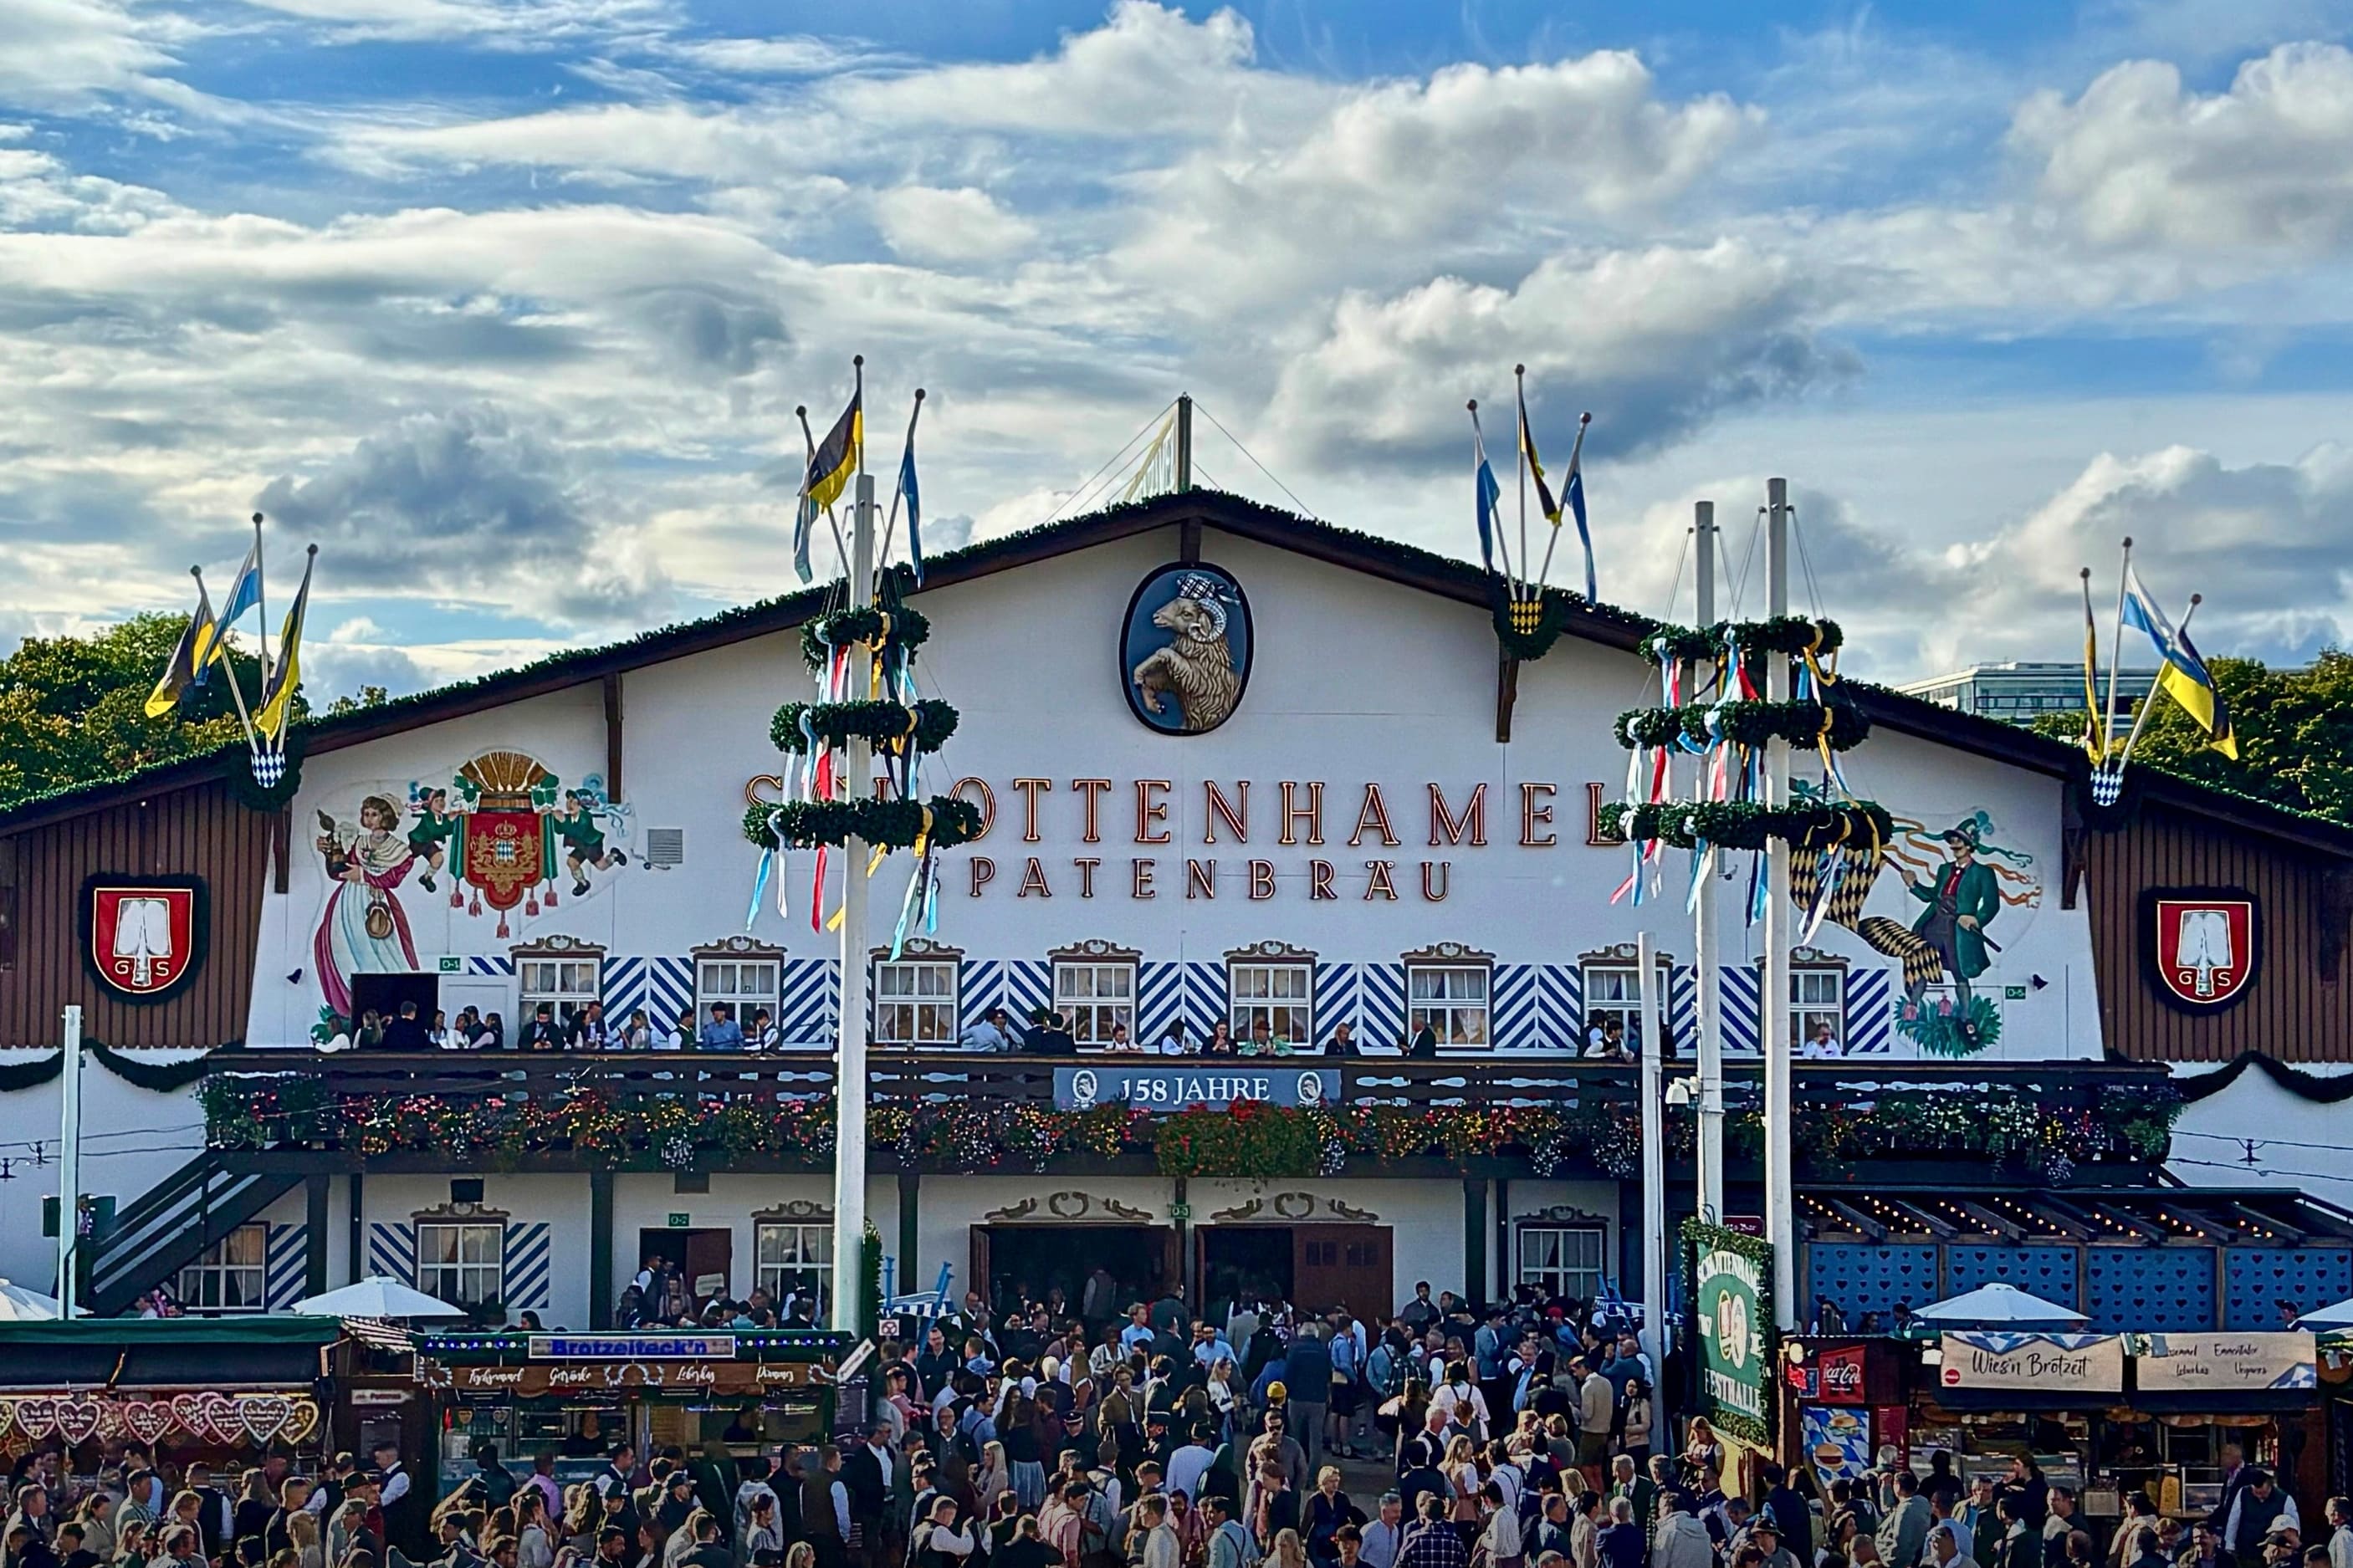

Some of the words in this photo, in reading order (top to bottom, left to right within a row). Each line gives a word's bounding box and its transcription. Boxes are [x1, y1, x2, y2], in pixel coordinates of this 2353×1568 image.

[744, 774, 1624, 846] OTTENHAMEL
[115, 960, 130, 975] G
[156, 961, 170, 977] S
[2178, 971, 2193, 985] G
[2217, 972, 2231, 987] S
[1122, 1078, 1168, 1102] 158
[1174, 1076, 1270, 1106] JAHRE
[2026, 1352, 2092, 1378] Brotzeit
